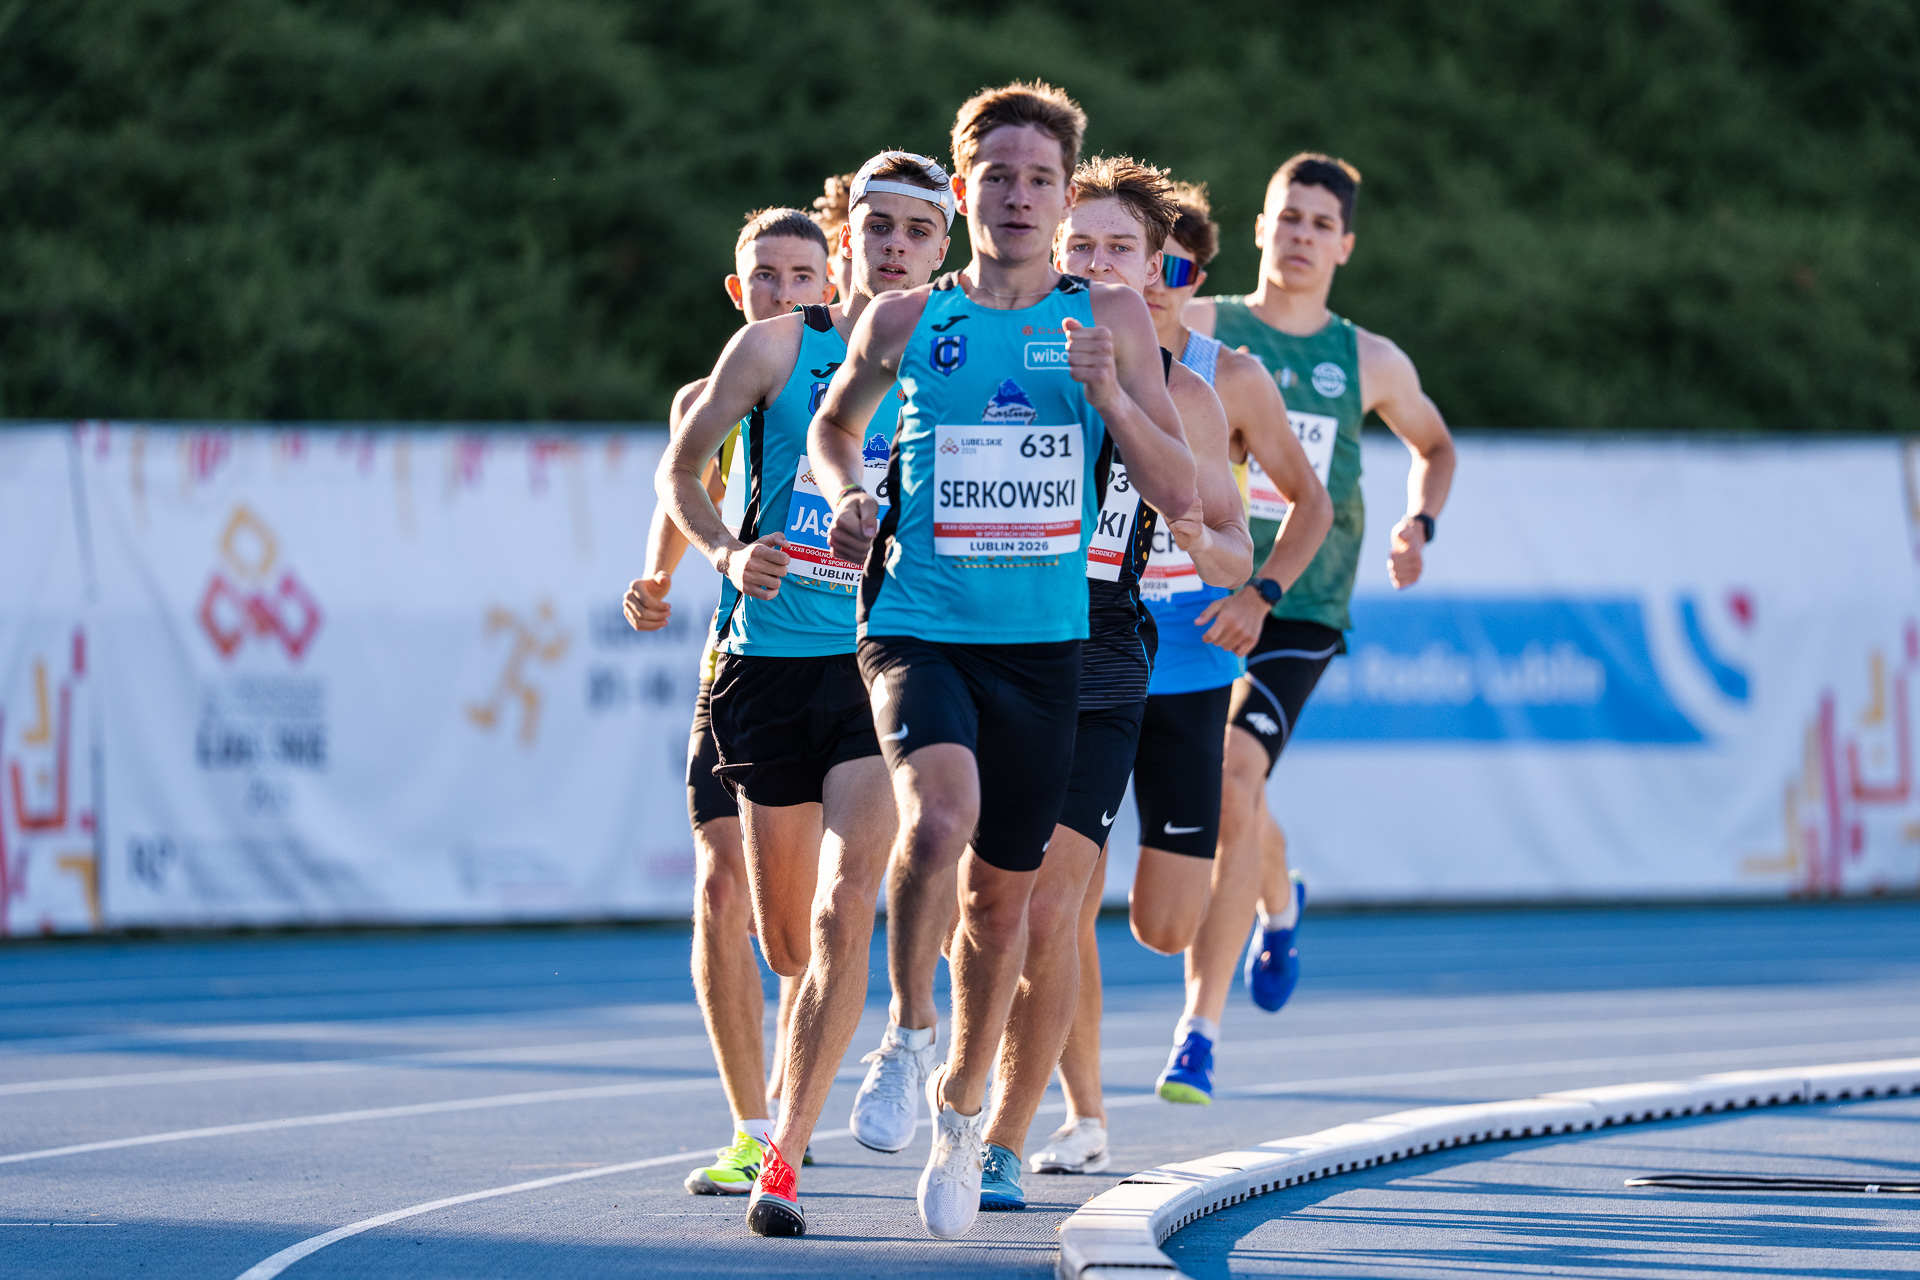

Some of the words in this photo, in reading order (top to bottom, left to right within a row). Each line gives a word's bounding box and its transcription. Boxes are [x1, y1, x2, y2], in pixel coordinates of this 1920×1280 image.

[1020, 433, 1072, 458] 631
[939, 479, 1076, 508] SERKOWSKI
[1096, 510, 1127, 539] KI
[970, 541, 1014, 551] LUBLIN
[1017, 541, 1049, 551] 2026
[812, 566, 855, 582] LUBLIN
[828, 560, 860, 569] SPORTACH
